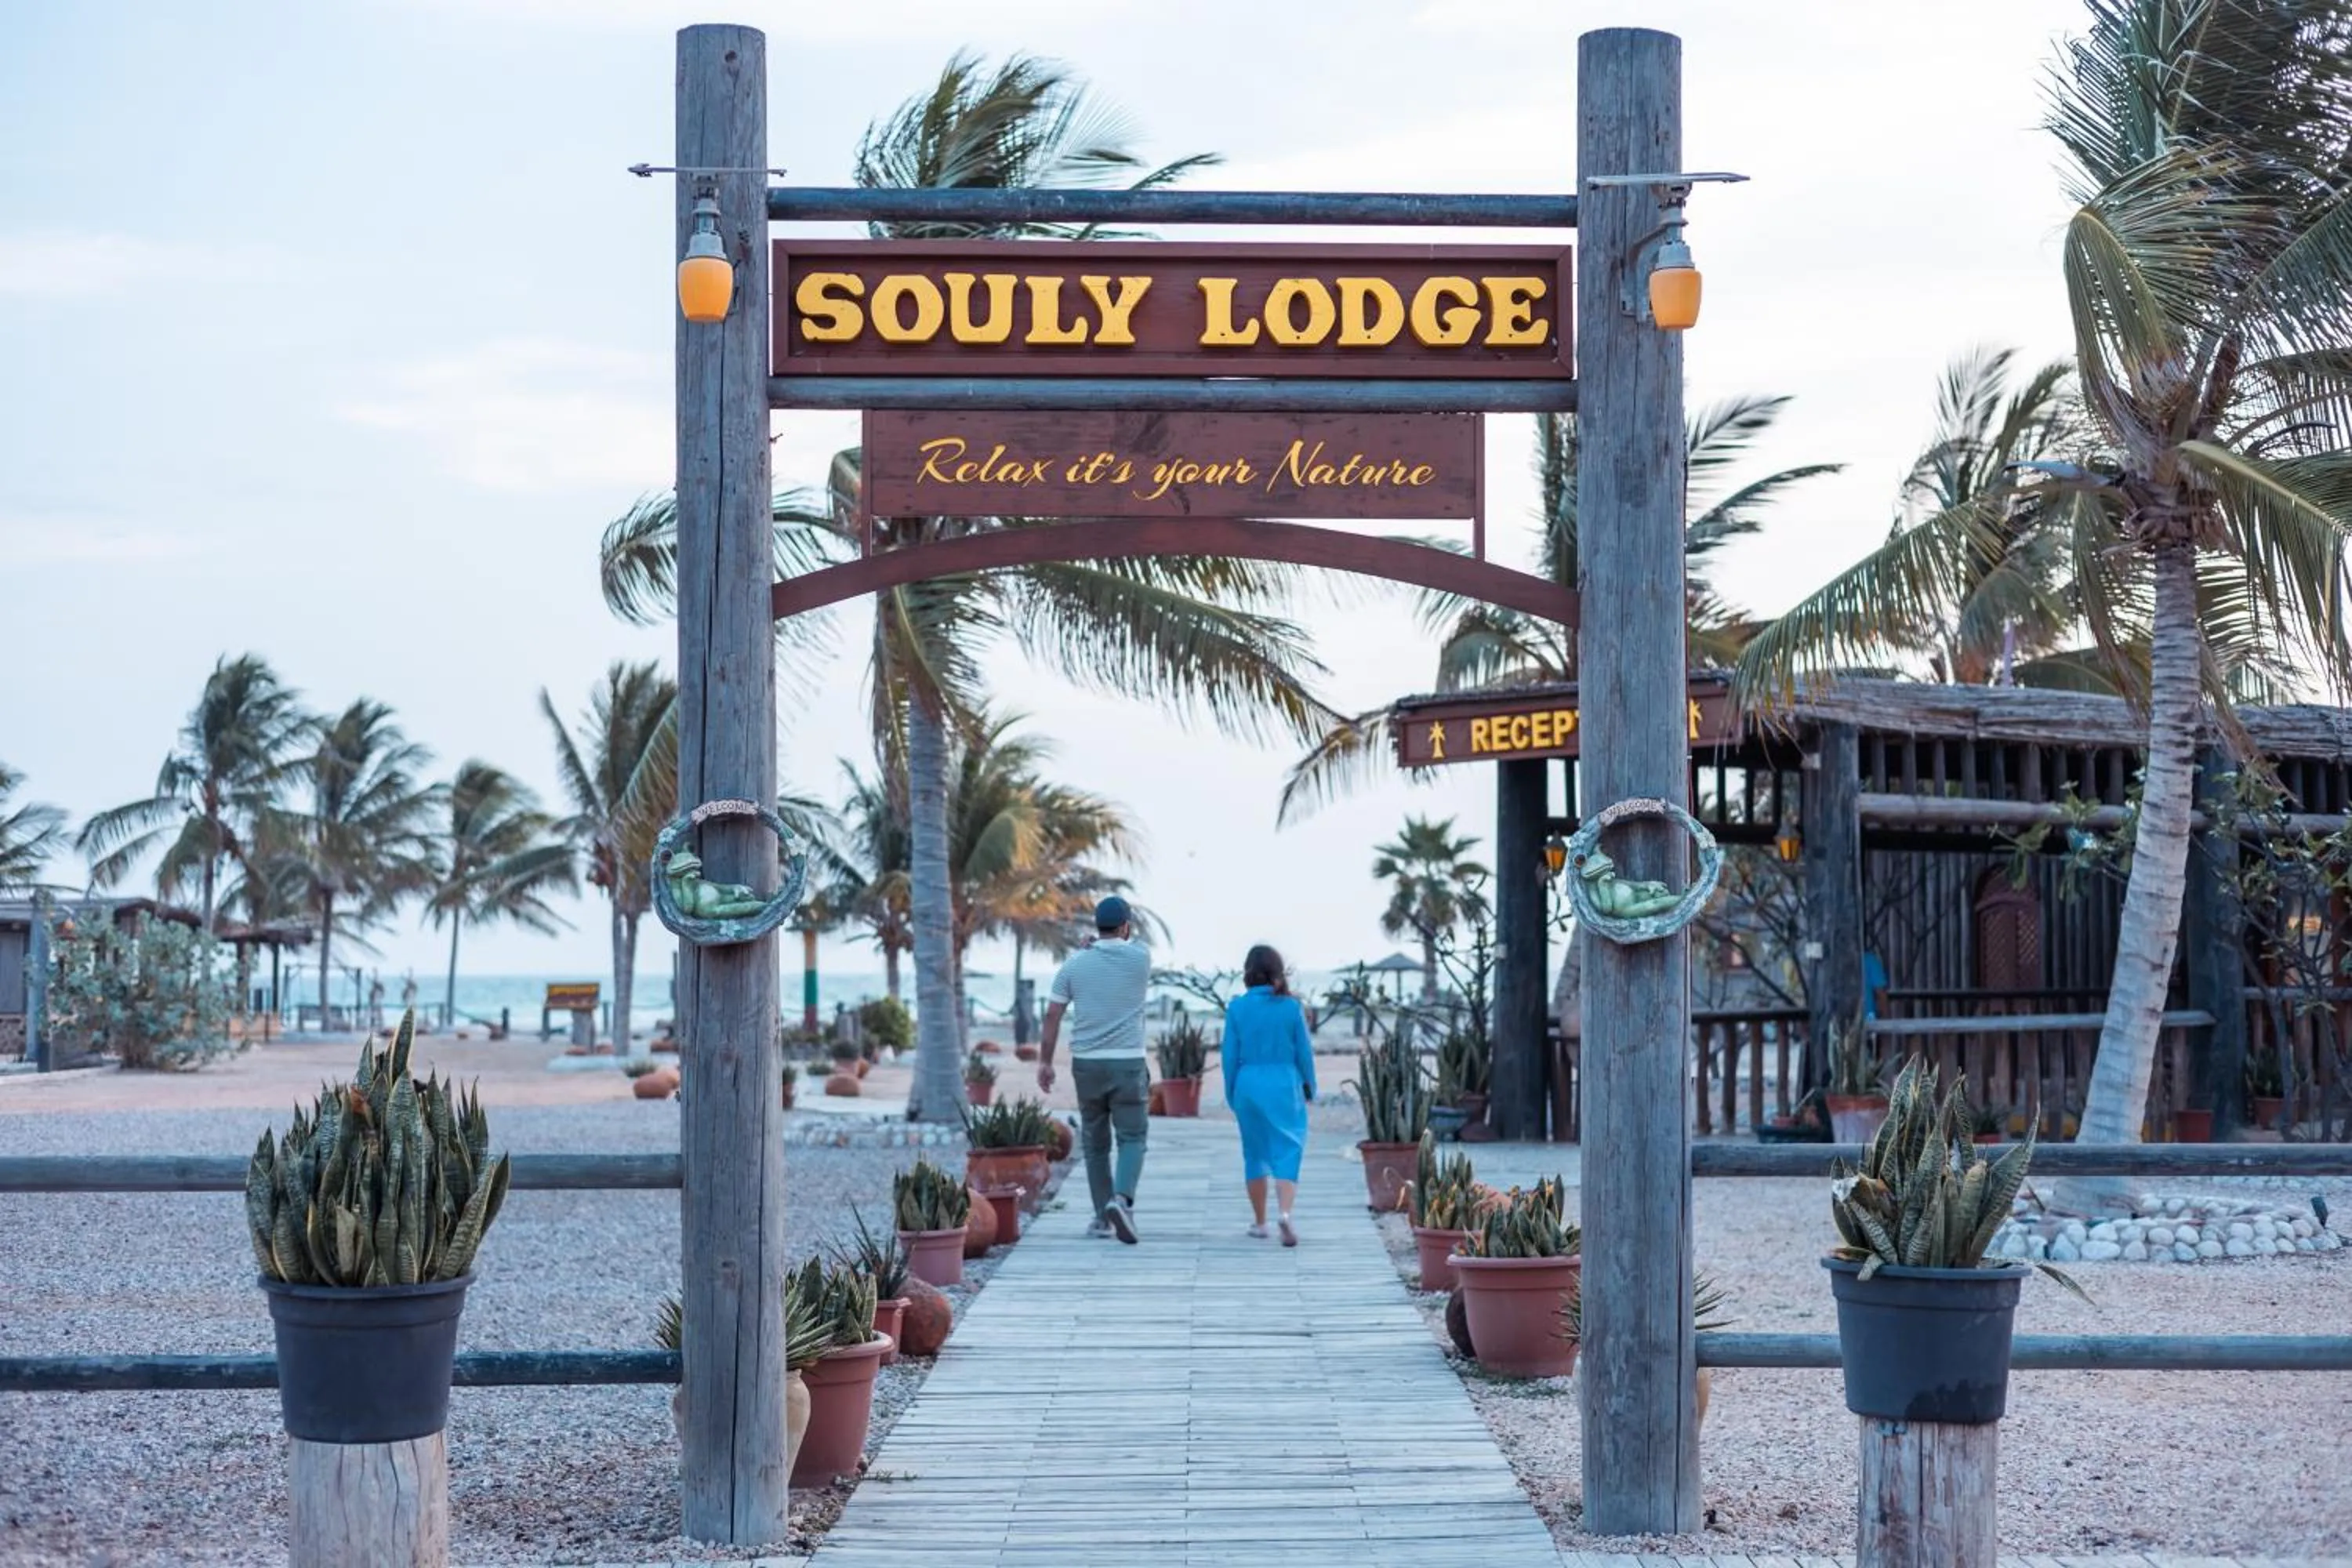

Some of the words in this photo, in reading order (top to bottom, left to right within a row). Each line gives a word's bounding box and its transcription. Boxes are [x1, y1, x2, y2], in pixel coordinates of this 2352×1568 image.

[795, 271, 1152, 347] SOULY
[1196, 276, 1551, 348] LODGE
[916, 435, 1055, 488] Relax
[1065, 450, 1136, 485] it's
[1132, 456, 1258, 502] your
[1265, 438, 1436, 494] Nature
[1470, 709, 1580, 754] RECEP
